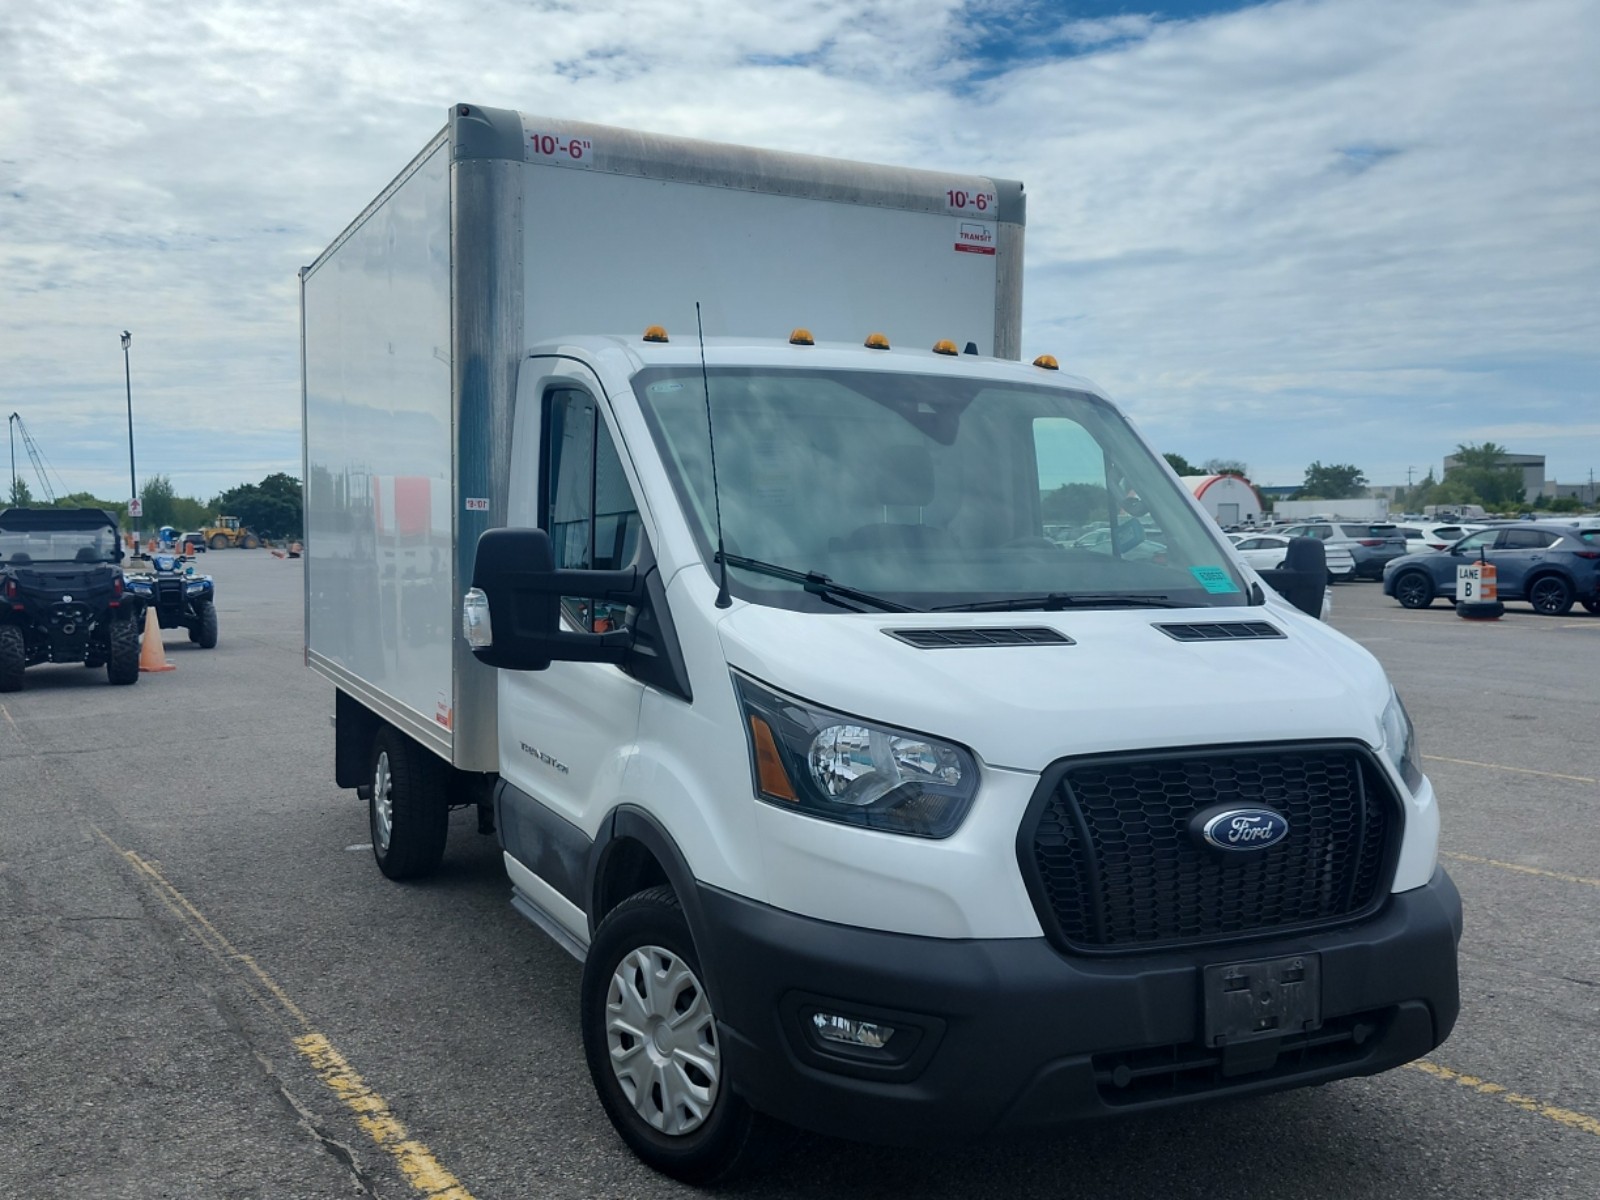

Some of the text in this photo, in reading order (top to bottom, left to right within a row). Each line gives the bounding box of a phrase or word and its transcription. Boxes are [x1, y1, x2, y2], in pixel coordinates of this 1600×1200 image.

[530, 134, 591, 159] 10'-6"
[946, 190, 993, 210] 10'-6"
[960, 232, 992, 242] TRANSIT
[1459, 568, 1479, 580] LANE
[1465, 582, 1473, 597] B
[1228, 816, 1273, 843] Ford
